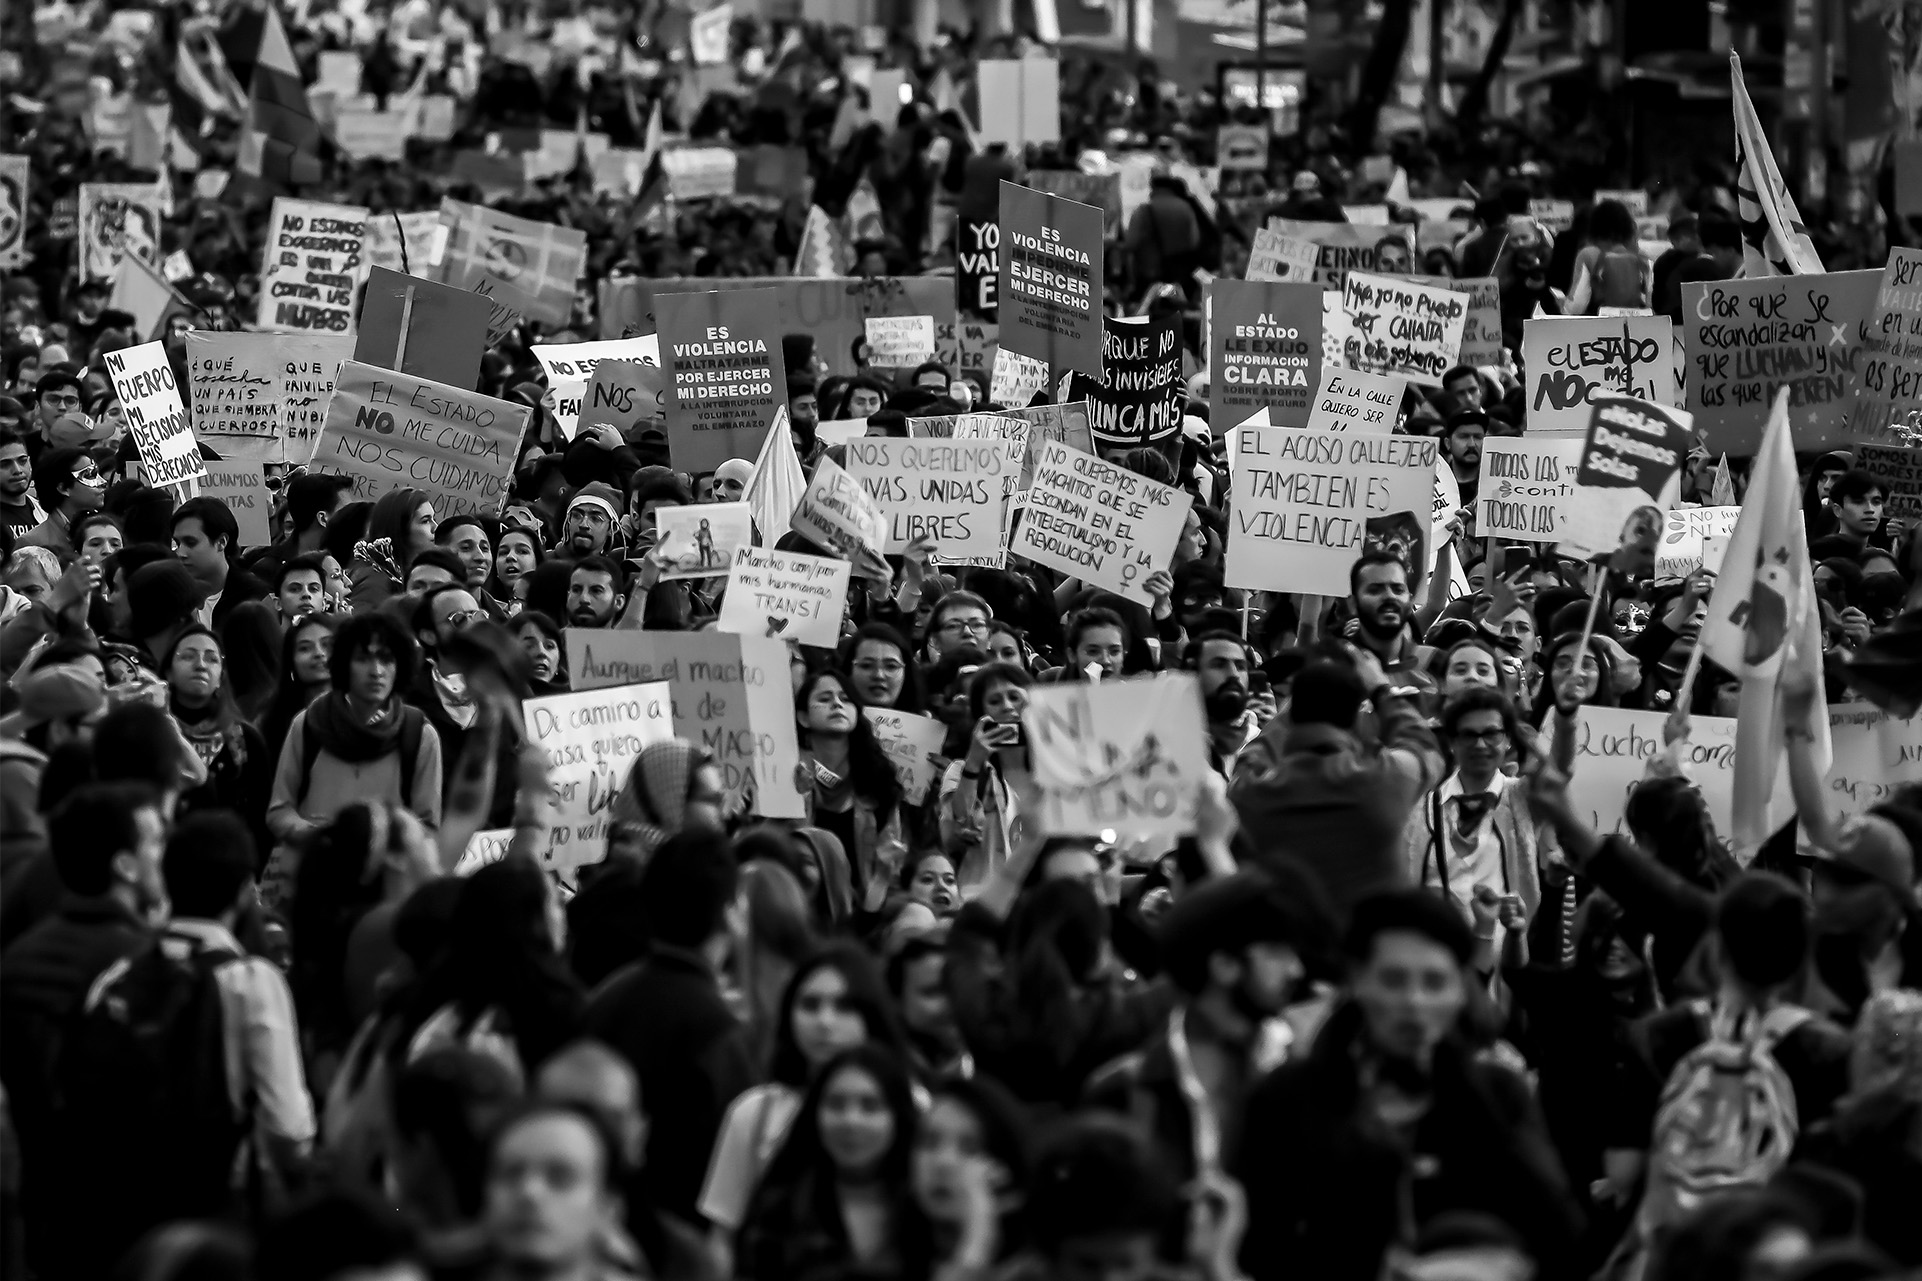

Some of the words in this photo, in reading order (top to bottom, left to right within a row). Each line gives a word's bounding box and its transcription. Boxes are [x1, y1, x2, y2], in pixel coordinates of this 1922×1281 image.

[282, 213, 304, 231] NO
[1041, 225, 1061, 242] ES
[1011, 231, 1091, 266] VIOLENCIA
[1011, 247, 1089, 279] IMPEDIRME
[1010, 260, 1090, 297] EJERCER
[1011, 278, 1025, 293] MI
[1027, 282, 1090, 311] DERECHO
[1018, 316, 1034, 328] DEL
[1036, 318, 1081, 340] EMBARAZO
[1024, 307, 1076, 328] VOLUNTARIA
[1257, 313, 1278, 325] AL
[706, 326, 730, 340] ES
[937, 324, 956, 340] SE
[965, 325, 985, 340] VA
[1158, 329, 1175, 358] NO
[1235, 325, 1299, 340] ESTADO
[1699, 321, 1816, 350] escandalizan
[673, 339, 767, 357] VIOLENCIA
[1224, 338, 1247, 353] LE
[1251, 339, 1309, 355] EXIJO
[1578, 336, 1659, 367] ESTADO
[106, 353, 126, 376] MI
[285, 361, 323, 375] QUE
[548, 360, 575, 376] NO
[674, 355, 770, 371] MALTRATARME
[1224, 353, 1309, 368] INFORMACIÓN
[1736, 345, 1814, 380] LUCHAN
[117, 365, 175, 404] CUERPO
[193, 370, 271, 386] cosecha
[675, 372, 705, 384] POR
[706, 368, 771, 382] EJERCER
[1223, 365, 1308, 387] CLARA
[194, 388, 211, 400] UN
[217, 386, 259, 400] PAÍS
[369, 380, 399, 407] EL
[410, 384, 496, 428] ESTADO
[593, 382, 638, 414] NOS
[677, 386, 695, 400] MI
[697, 382, 773, 399] DERECHO
[1222, 385, 1259, 395] SOBRE
[1261, 386, 1308, 398] ABORTO
[1222, 397, 1252, 406] LIBRE
[1254, 398, 1260, 406] Y
[1267, 398, 1307, 409] SEGURO
[1347, 385, 1361, 398] LA
[1365, 389, 1396, 406] CALLE
[1533, 369, 1586, 412] NO
[1700, 382, 1727, 408] las
[1766, 373, 1845, 409] MEREN
[126, 405, 146, 429] MI
[195, 403, 220, 416] QUE
[224, 403, 278, 417] SIEMBRA
[680, 402, 688, 411] A
[689, 401, 701, 409] LA
[697, 409, 758, 420] VOLUNTARIA
[1148, 387, 1180, 431] MÁS
[1320, 399, 1360, 418] QUIERO
[1362, 409, 1385, 424] SER
[133, 404, 191, 449] DECISIÓN
[354, 405, 395, 435] NO
[402, 418, 434, 442] ME
[436, 427, 501, 465] CUIDA
[692, 423, 710, 431] DEL
[712, 419, 765, 431] EMBARAZO
[140, 444, 164, 466] MIS
[850, 443, 890, 468] NOS
[900, 444, 1002, 476] QUEREMOS
[1240, 430, 1271, 456] EL
[1281, 434, 1344, 465] ACOSO
[1349, 438, 1437, 468] CALLEJERO
[1857, 447, 1909, 466] SOMOS
[147, 447, 205, 485] DERECHOS
[336, 435, 404, 473] NOS
[409, 456, 511, 499] CUIDAMOS
[1044, 447, 1067, 466] NO
[1073, 457, 1138, 496] QUEREMOS
[1142, 484, 1174, 507] MÁS
[1485, 450, 1530, 480] TODAS
[1534, 455, 1561, 482] LAS
[1854, 460, 1914, 481] MADRES
[198, 473, 260, 488] LUCHAMOS
[920, 478, 990, 505] UNIDAS
[1037, 467, 1096, 501] MACHITOS
[1098, 489, 1127, 513] QUE
[1126, 500, 1149, 520] SE
[1247, 468, 1358, 510] TAMBIEN
[1366, 476, 1391, 512] ES
[893, 512, 972, 542] LIBRES
[1030, 486, 1089, 522] ESCONDAN
[1091, 512, 1113, 532] EN
[1115, 521, 1136, 542] EL
[1482, 499, 1527, 530] TODAS
[1530, 503, 1555, 533] LAS
[1689, 510, 1713, 523] NO
[1025, 507, 1118, 556] INTELECTUALISMO
[1121, 543, 1134, 559] Y
[1136, 550, 1153, 570] LA
[1238, 508, 1366, 551] VIOLENCIA
[1690, 523, 1712, 538] NI
[736, 548, 785, 572] Marcho
[739, 573, 762, 588] mis
[768, 573, 833, 600] hermanas
[581, 643, 653, 681] Aunque
[660, 657, 679, 682] el
[689, 657, 765, 688] macho
[569, 700, 641, 732] camino
[646, 698, 663, 719] a
[696, 691, 726, 722] de
[702, 725, 775, 760] MACHO
[1576, 721, 1657, 761] Lucha
[591, 734, 643, 776] quiero
